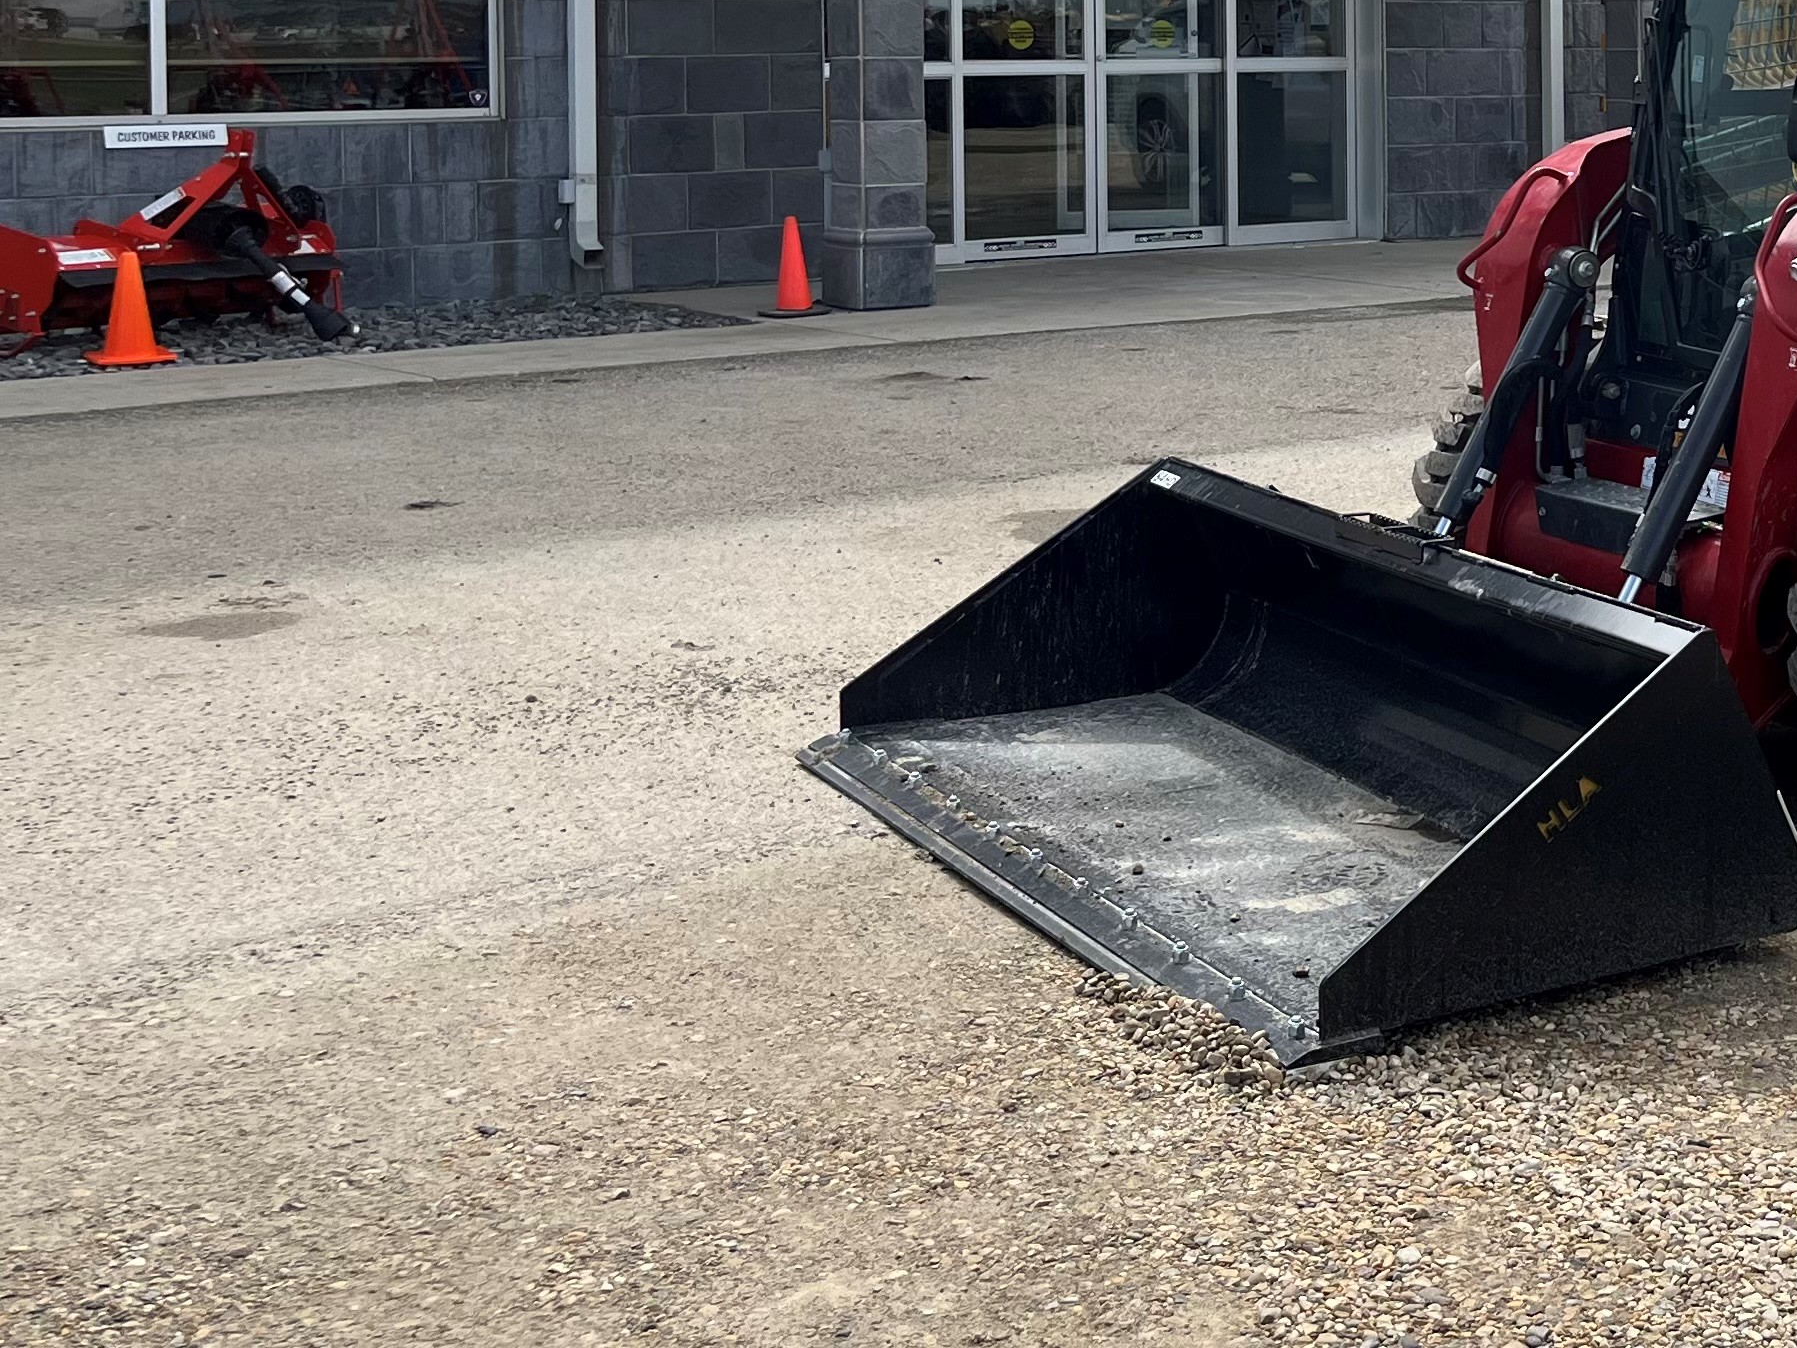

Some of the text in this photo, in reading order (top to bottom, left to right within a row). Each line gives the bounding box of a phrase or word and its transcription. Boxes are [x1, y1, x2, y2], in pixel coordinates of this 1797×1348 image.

[117, 130, 215, 142] CUSTOMER PARKING
[1537, 776, 1602, 843] HLA
